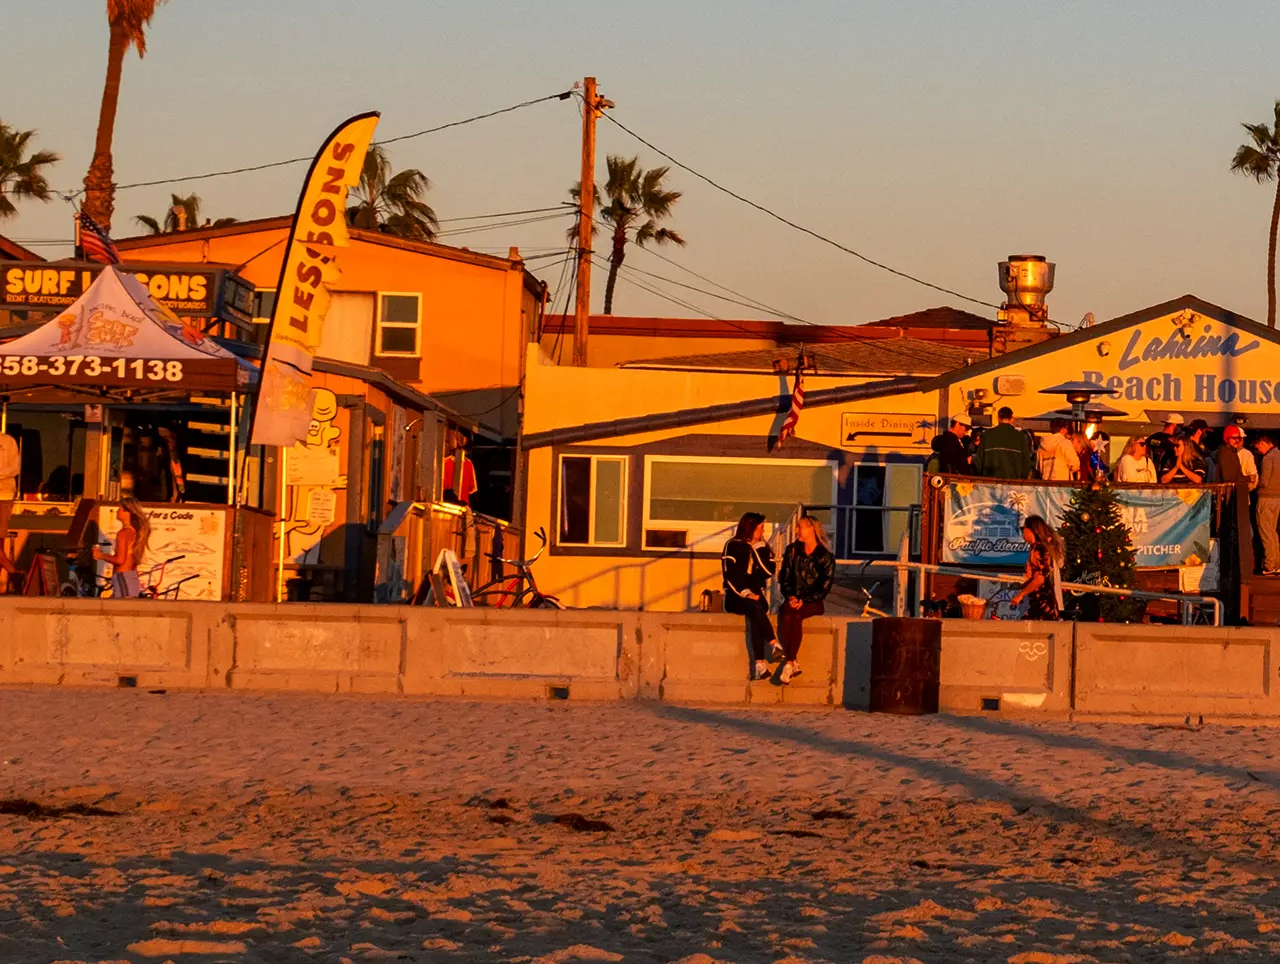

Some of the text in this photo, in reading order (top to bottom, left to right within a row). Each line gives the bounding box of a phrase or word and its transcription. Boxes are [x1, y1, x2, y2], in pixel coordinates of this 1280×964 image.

[289, 141, 355, 333] LESSONS
[6, 268, 75, 295] SURF
[6, 294, 26, 303] RENT
[1118, 324, 1260, 371] Lahaina
[0, 355, 183, 382] 58-373-1138
[845, 417, 915, 432] Inside Dining
[949, 537, 1031, 556] Pacific Beach
[1137, 543, 1182, 556] PITCHER
